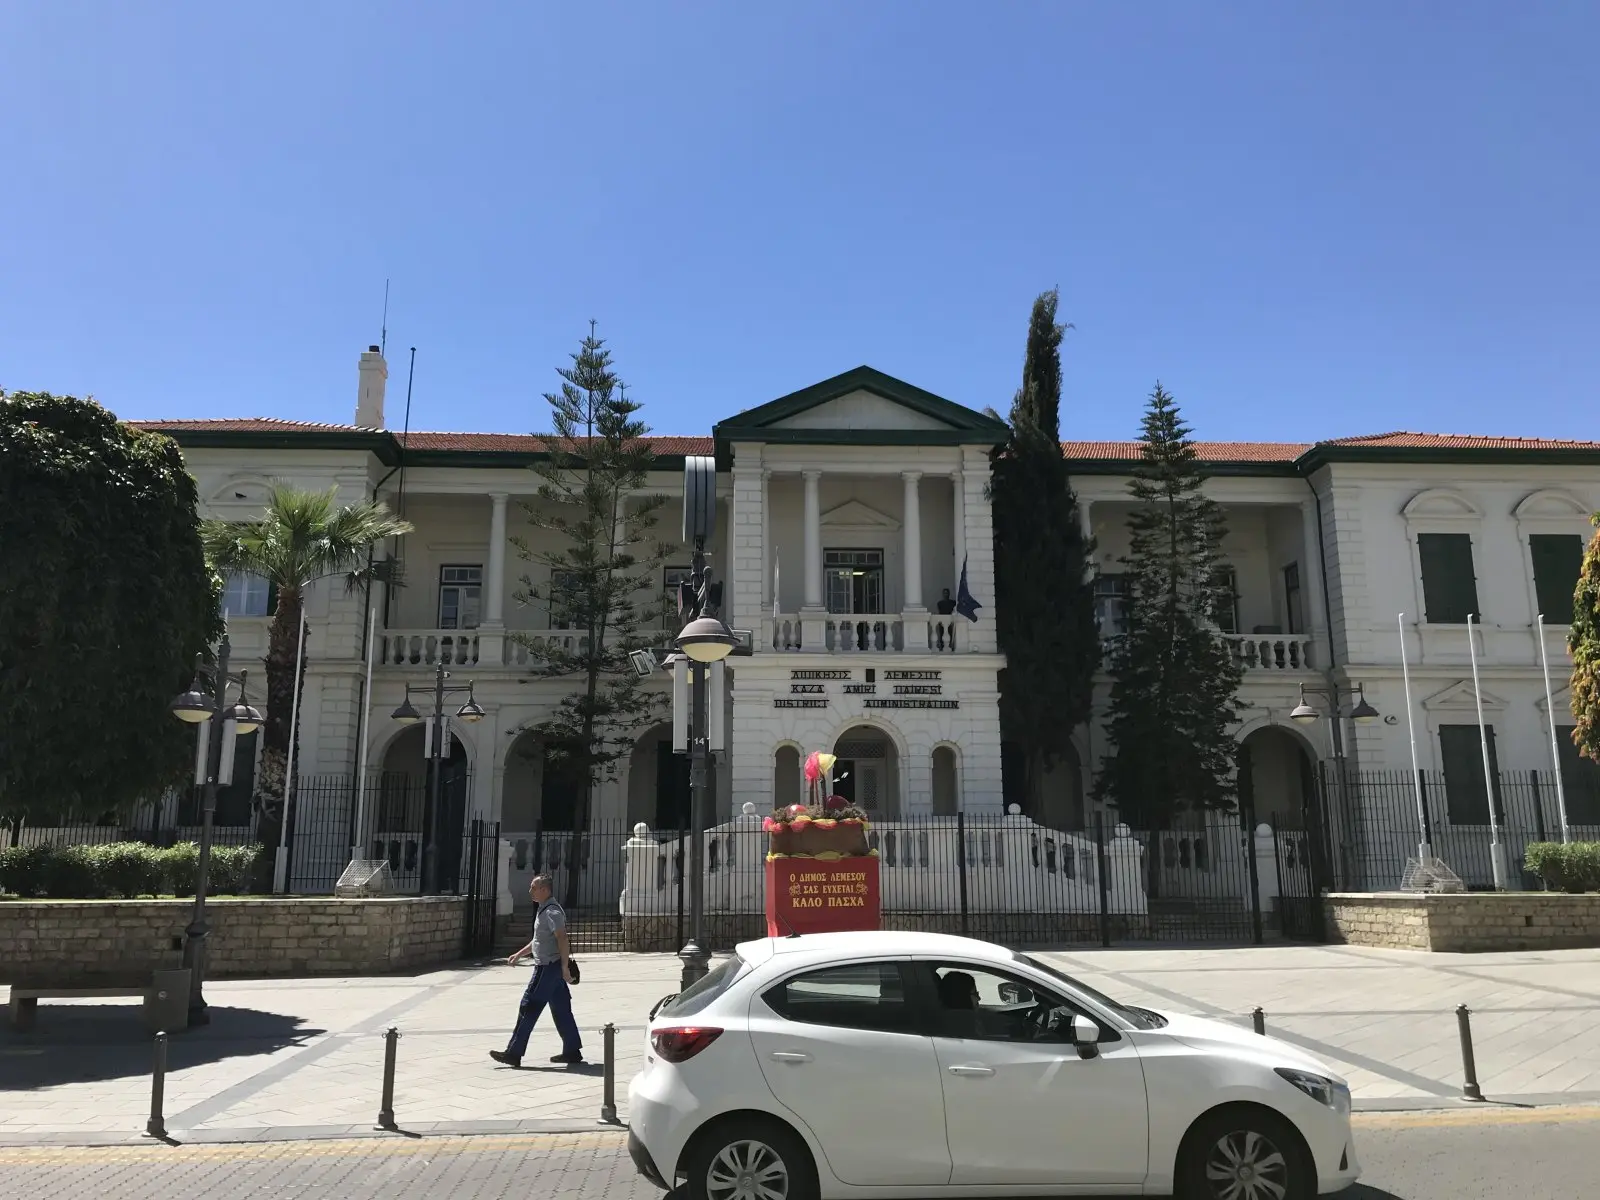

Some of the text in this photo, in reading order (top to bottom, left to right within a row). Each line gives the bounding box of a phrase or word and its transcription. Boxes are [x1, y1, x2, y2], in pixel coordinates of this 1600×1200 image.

[791, 684, 824, 693] KAZA
[774, 699, 959, 709] DISTRICT ADMINISTRATION
[694, 737, 705, 745] 14
[789, 872, 866, 882] Ο ΔΗΜΟΣ ΛΕΜΕΣΟΥ
[803, 884, 854, 894] ΣΑΣ ΕΥΧΕΤΑΙ
[792, 896, 865, 908] ΚΑΛΟ ΠΑΣΧΑ
